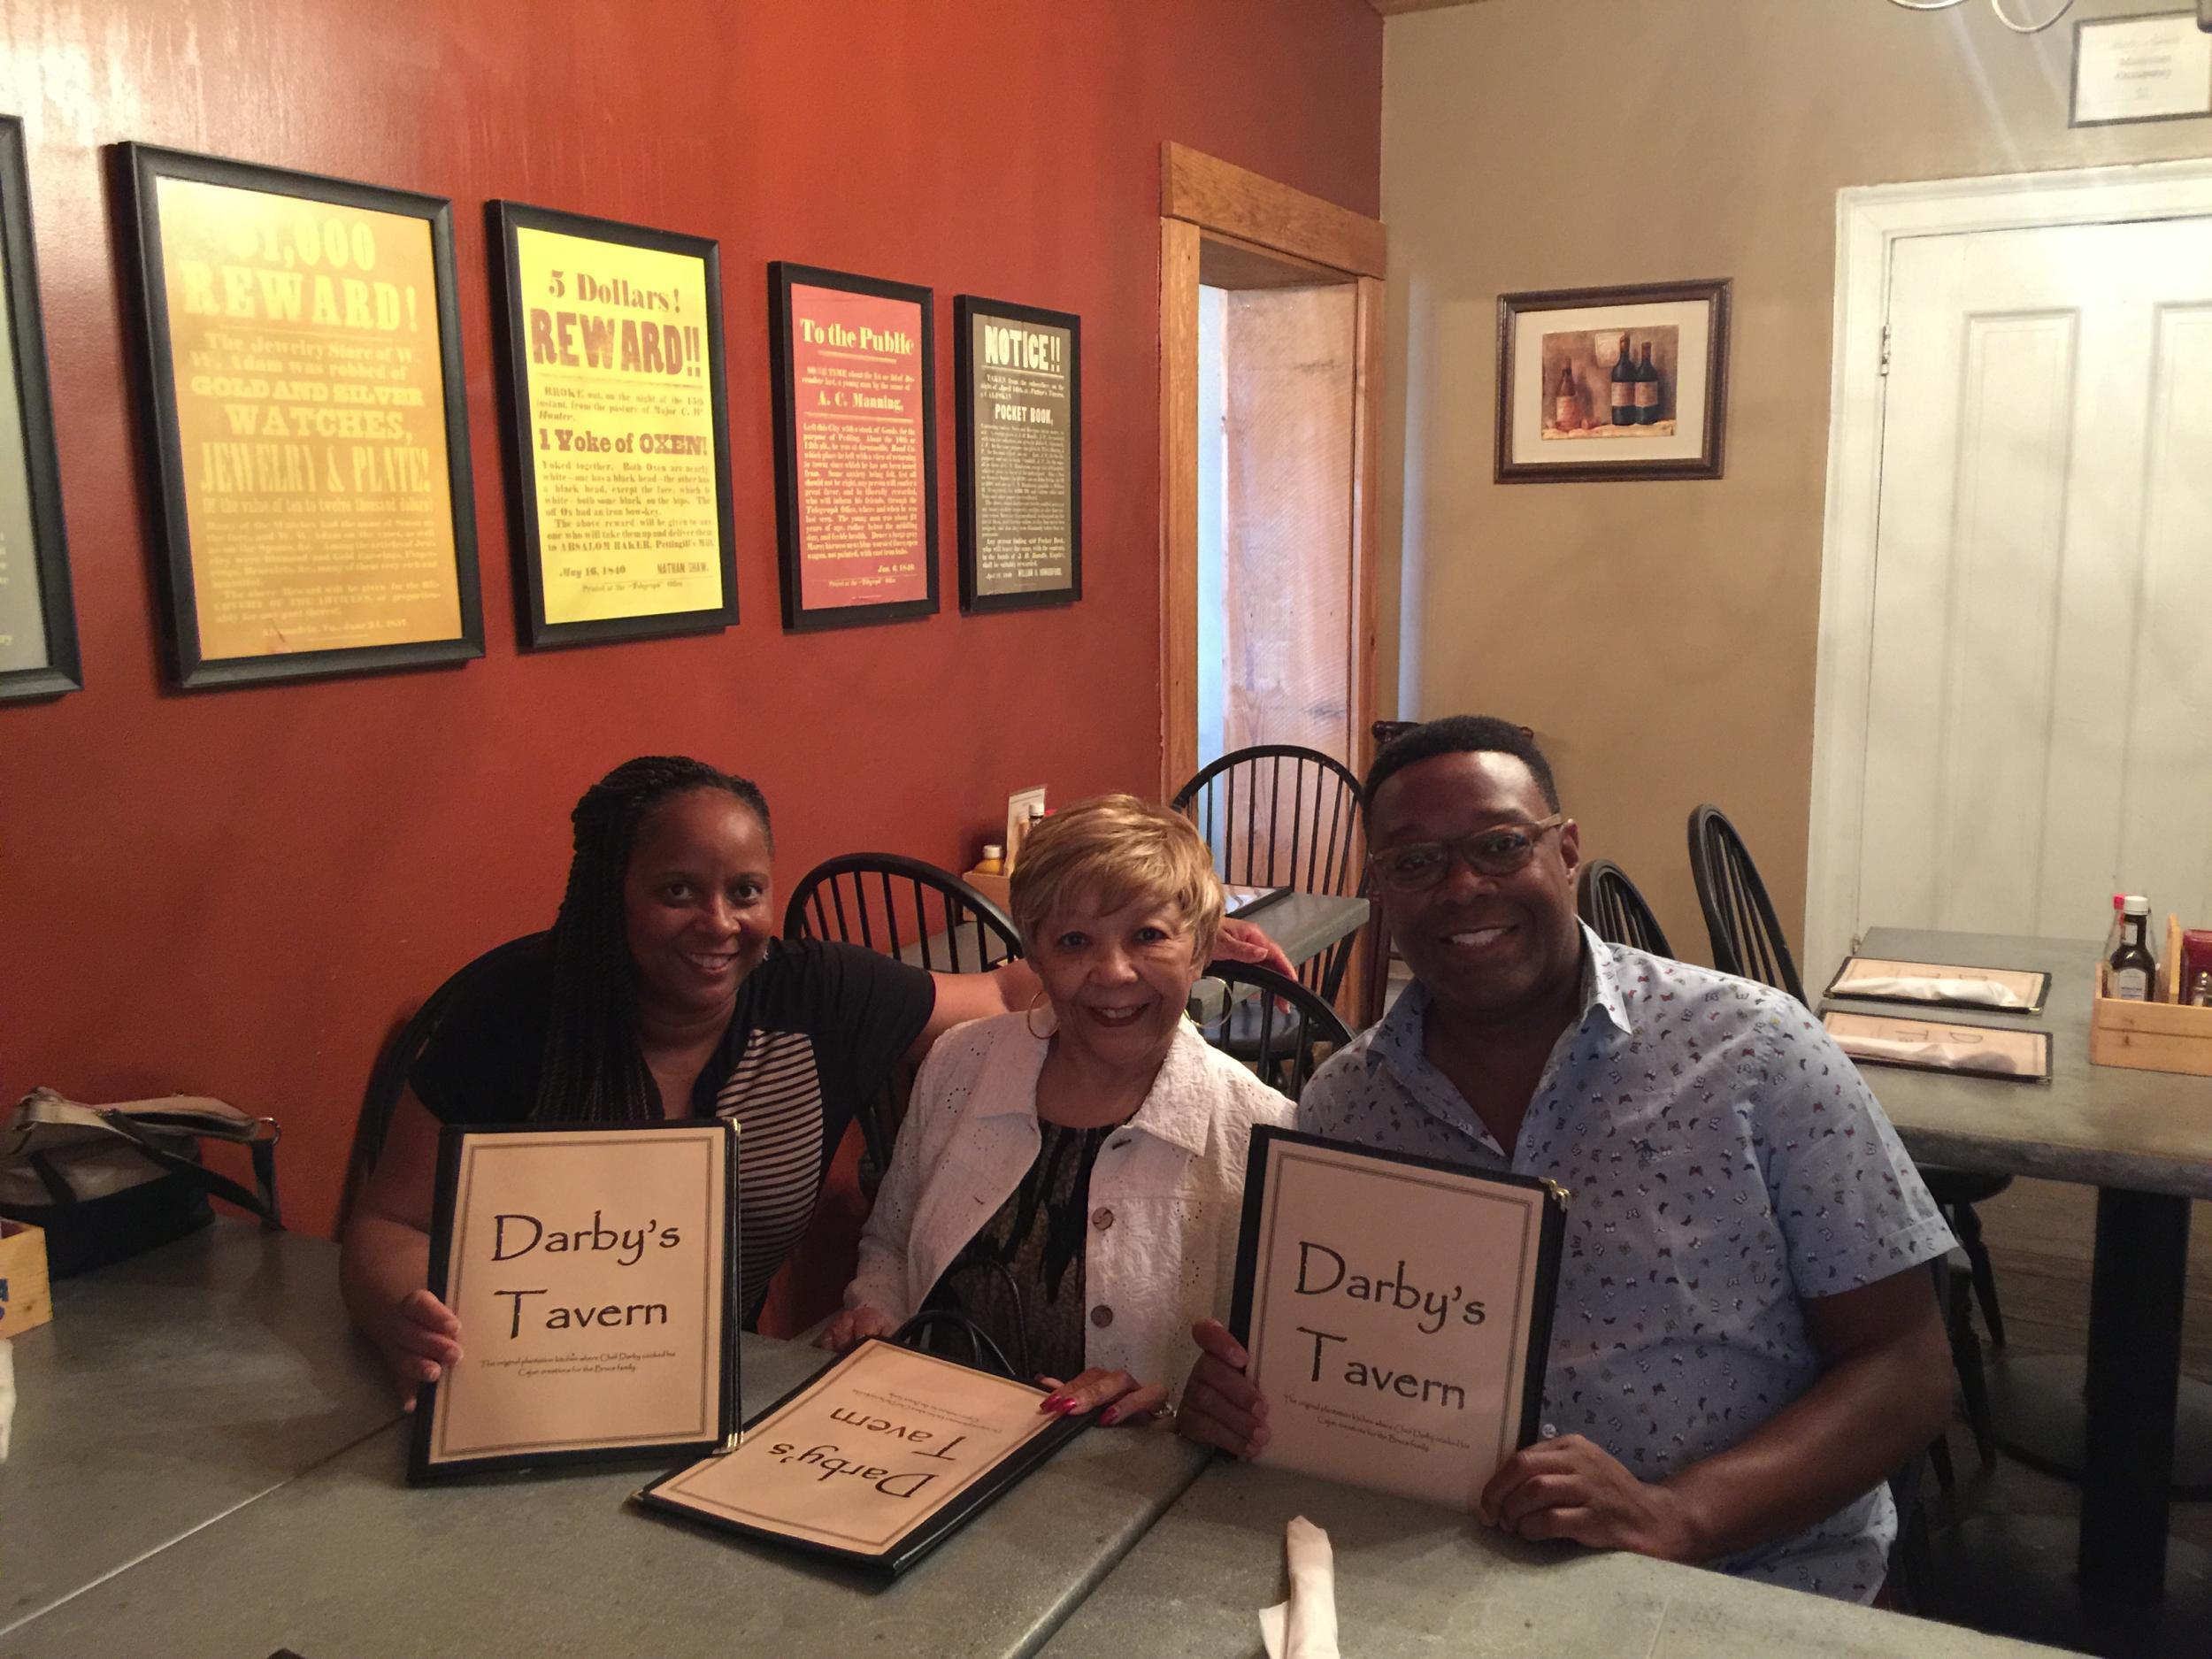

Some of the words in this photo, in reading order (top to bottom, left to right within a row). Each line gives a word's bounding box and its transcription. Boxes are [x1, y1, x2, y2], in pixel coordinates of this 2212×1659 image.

[181, 260, 419, 333] REWARD!
[549, 270, 565, 298] 5
[577, 273, 681, 314] Dollars!
[204, 333, 243, 352] The
[376, 346, 394, 362] of
[530, 307, 702, 378] REWARD!!
[800, 319, 826, 345] To
[827, 323, 857, 349] the
[859, 326, 915, 356] Public
[984, 325, 1061, 373] NOTICE!!
[190, 376, 271, 399] GOLD
[272, 380, 329, 402] AND
[333, 384, 426, 407] SILVER
[818, 390, 832, 407] A.
[995, 403, 1027, 423] POCKET
[224, 404, 413, 443] WATCHES,
[555, 429, 611, 454] Yoke
[614, 432, 634, 454] of
[639, 433, 708, 457] OXEN!
[490, 1210, 681, 1267] Darby's
[1294, 1240, 1486, 1334] Darby's
[493, 1288, 669, 1340] Tavern
[1295, 1325, 1467, 1410] Tavern
[829, 1406, 968, 1462] Tavern
[768, 1440, 941, 1501] Darby's
